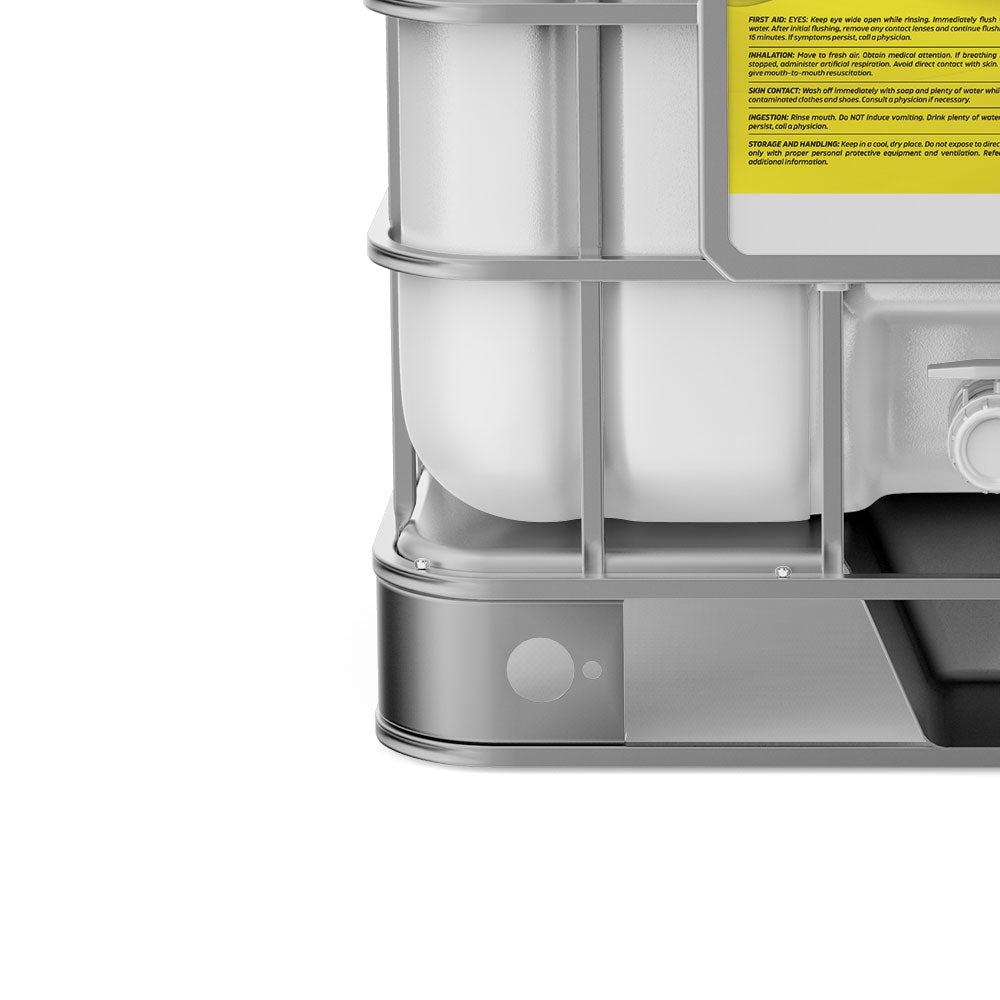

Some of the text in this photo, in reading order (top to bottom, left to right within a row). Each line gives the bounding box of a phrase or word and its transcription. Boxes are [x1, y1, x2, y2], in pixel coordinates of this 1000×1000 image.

[810, 16, 827, 24] Keep
[904, 16, 930, 24] rinsing.
[933, 16, 977, 24] Immediately
[812, 25, 841, 33] flushing,
[963, 52, 997, 60] breathing
[748, 61, 778, 69] stopped,
[851, 61, 890, 69] respiration.
[834, 87, 878, 95] immediately
[930, 87, 952, 95] plenty
[892, 114, 924, 122] vomiting.
[947, 114, 969, 122] plenty
[841, 141, 858, 149] Keep
[873, 141, 889, 149] cool,
[889, 141, 902, 149] dry
[903, 141, 923, 149] place.
[748, 150, 764, 158] only
[811, 150, 843, 158] personal
[845, 150, 880, 158] protective
[883, 150, 921, 158] equipment
